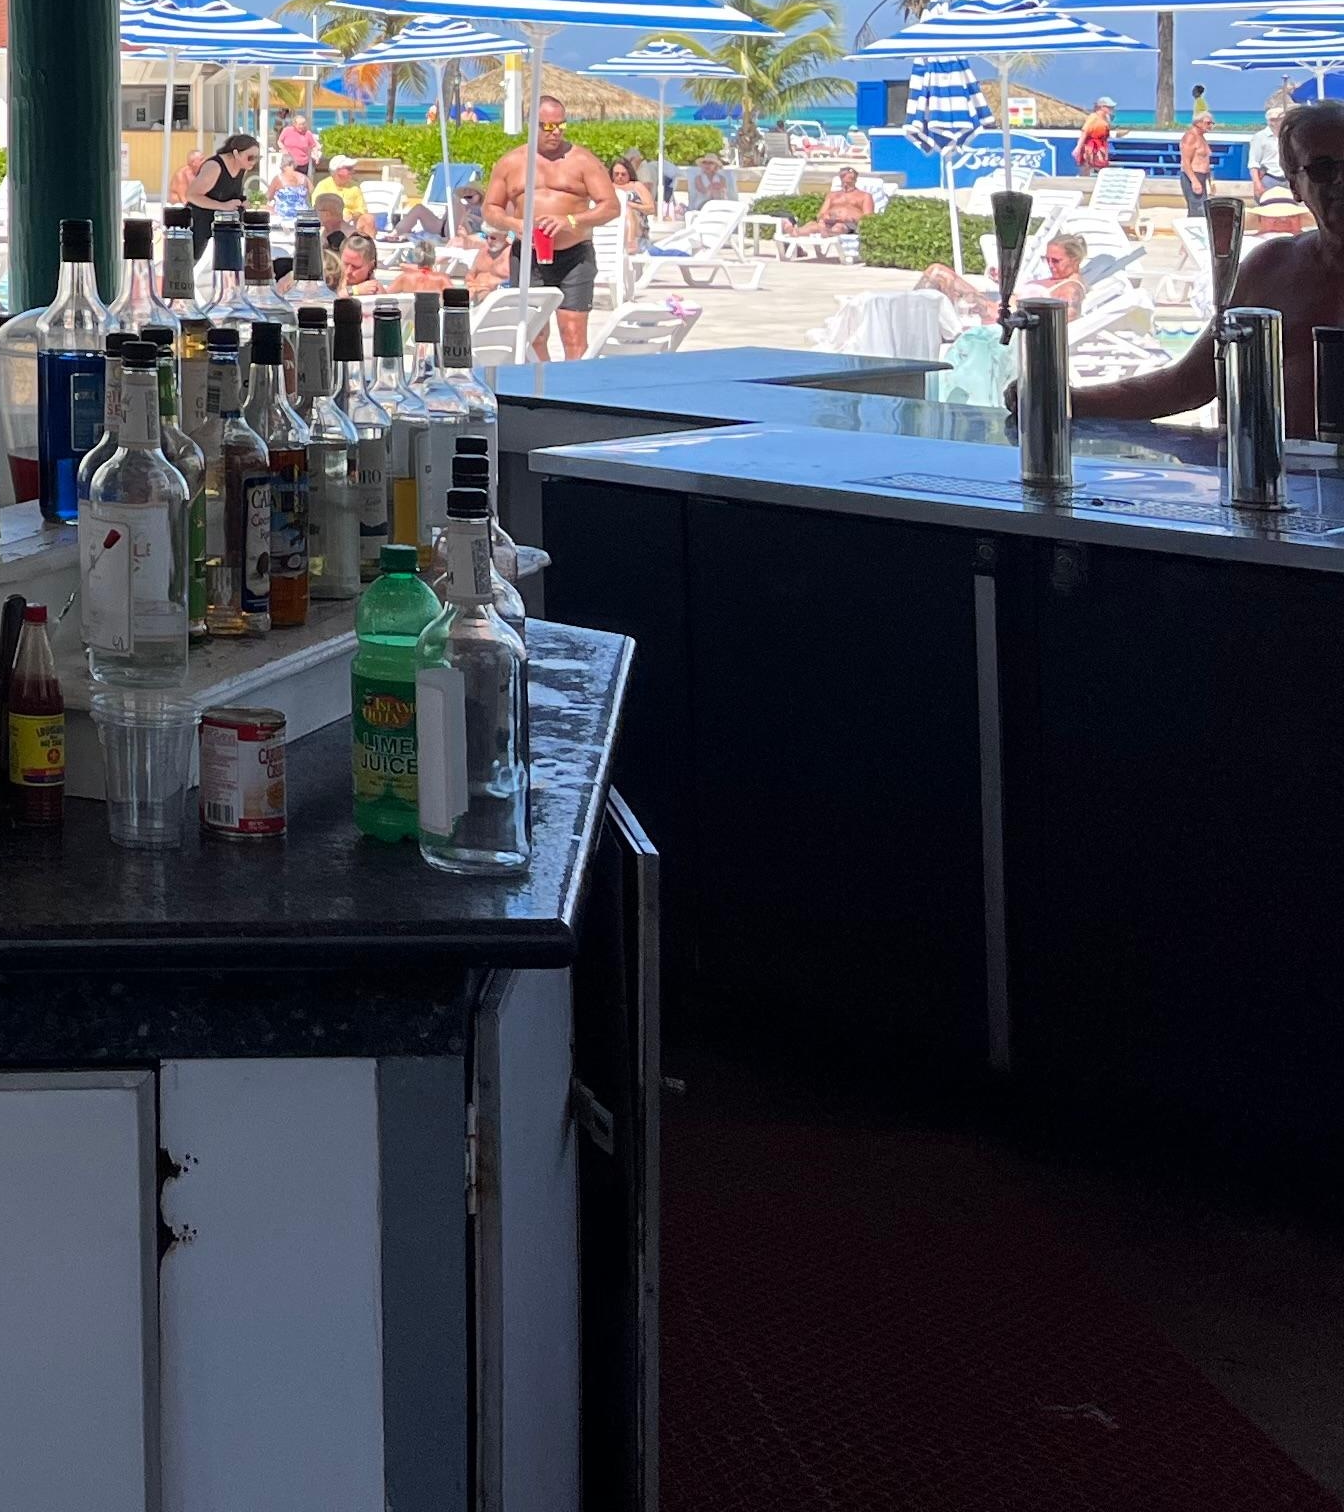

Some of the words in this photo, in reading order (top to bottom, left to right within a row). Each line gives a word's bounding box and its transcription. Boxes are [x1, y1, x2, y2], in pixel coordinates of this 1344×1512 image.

[169, 280, 195, 289] TEQU
[363, 731, 416, 756] LIME
[361, 754, 418, 776] JUICE
